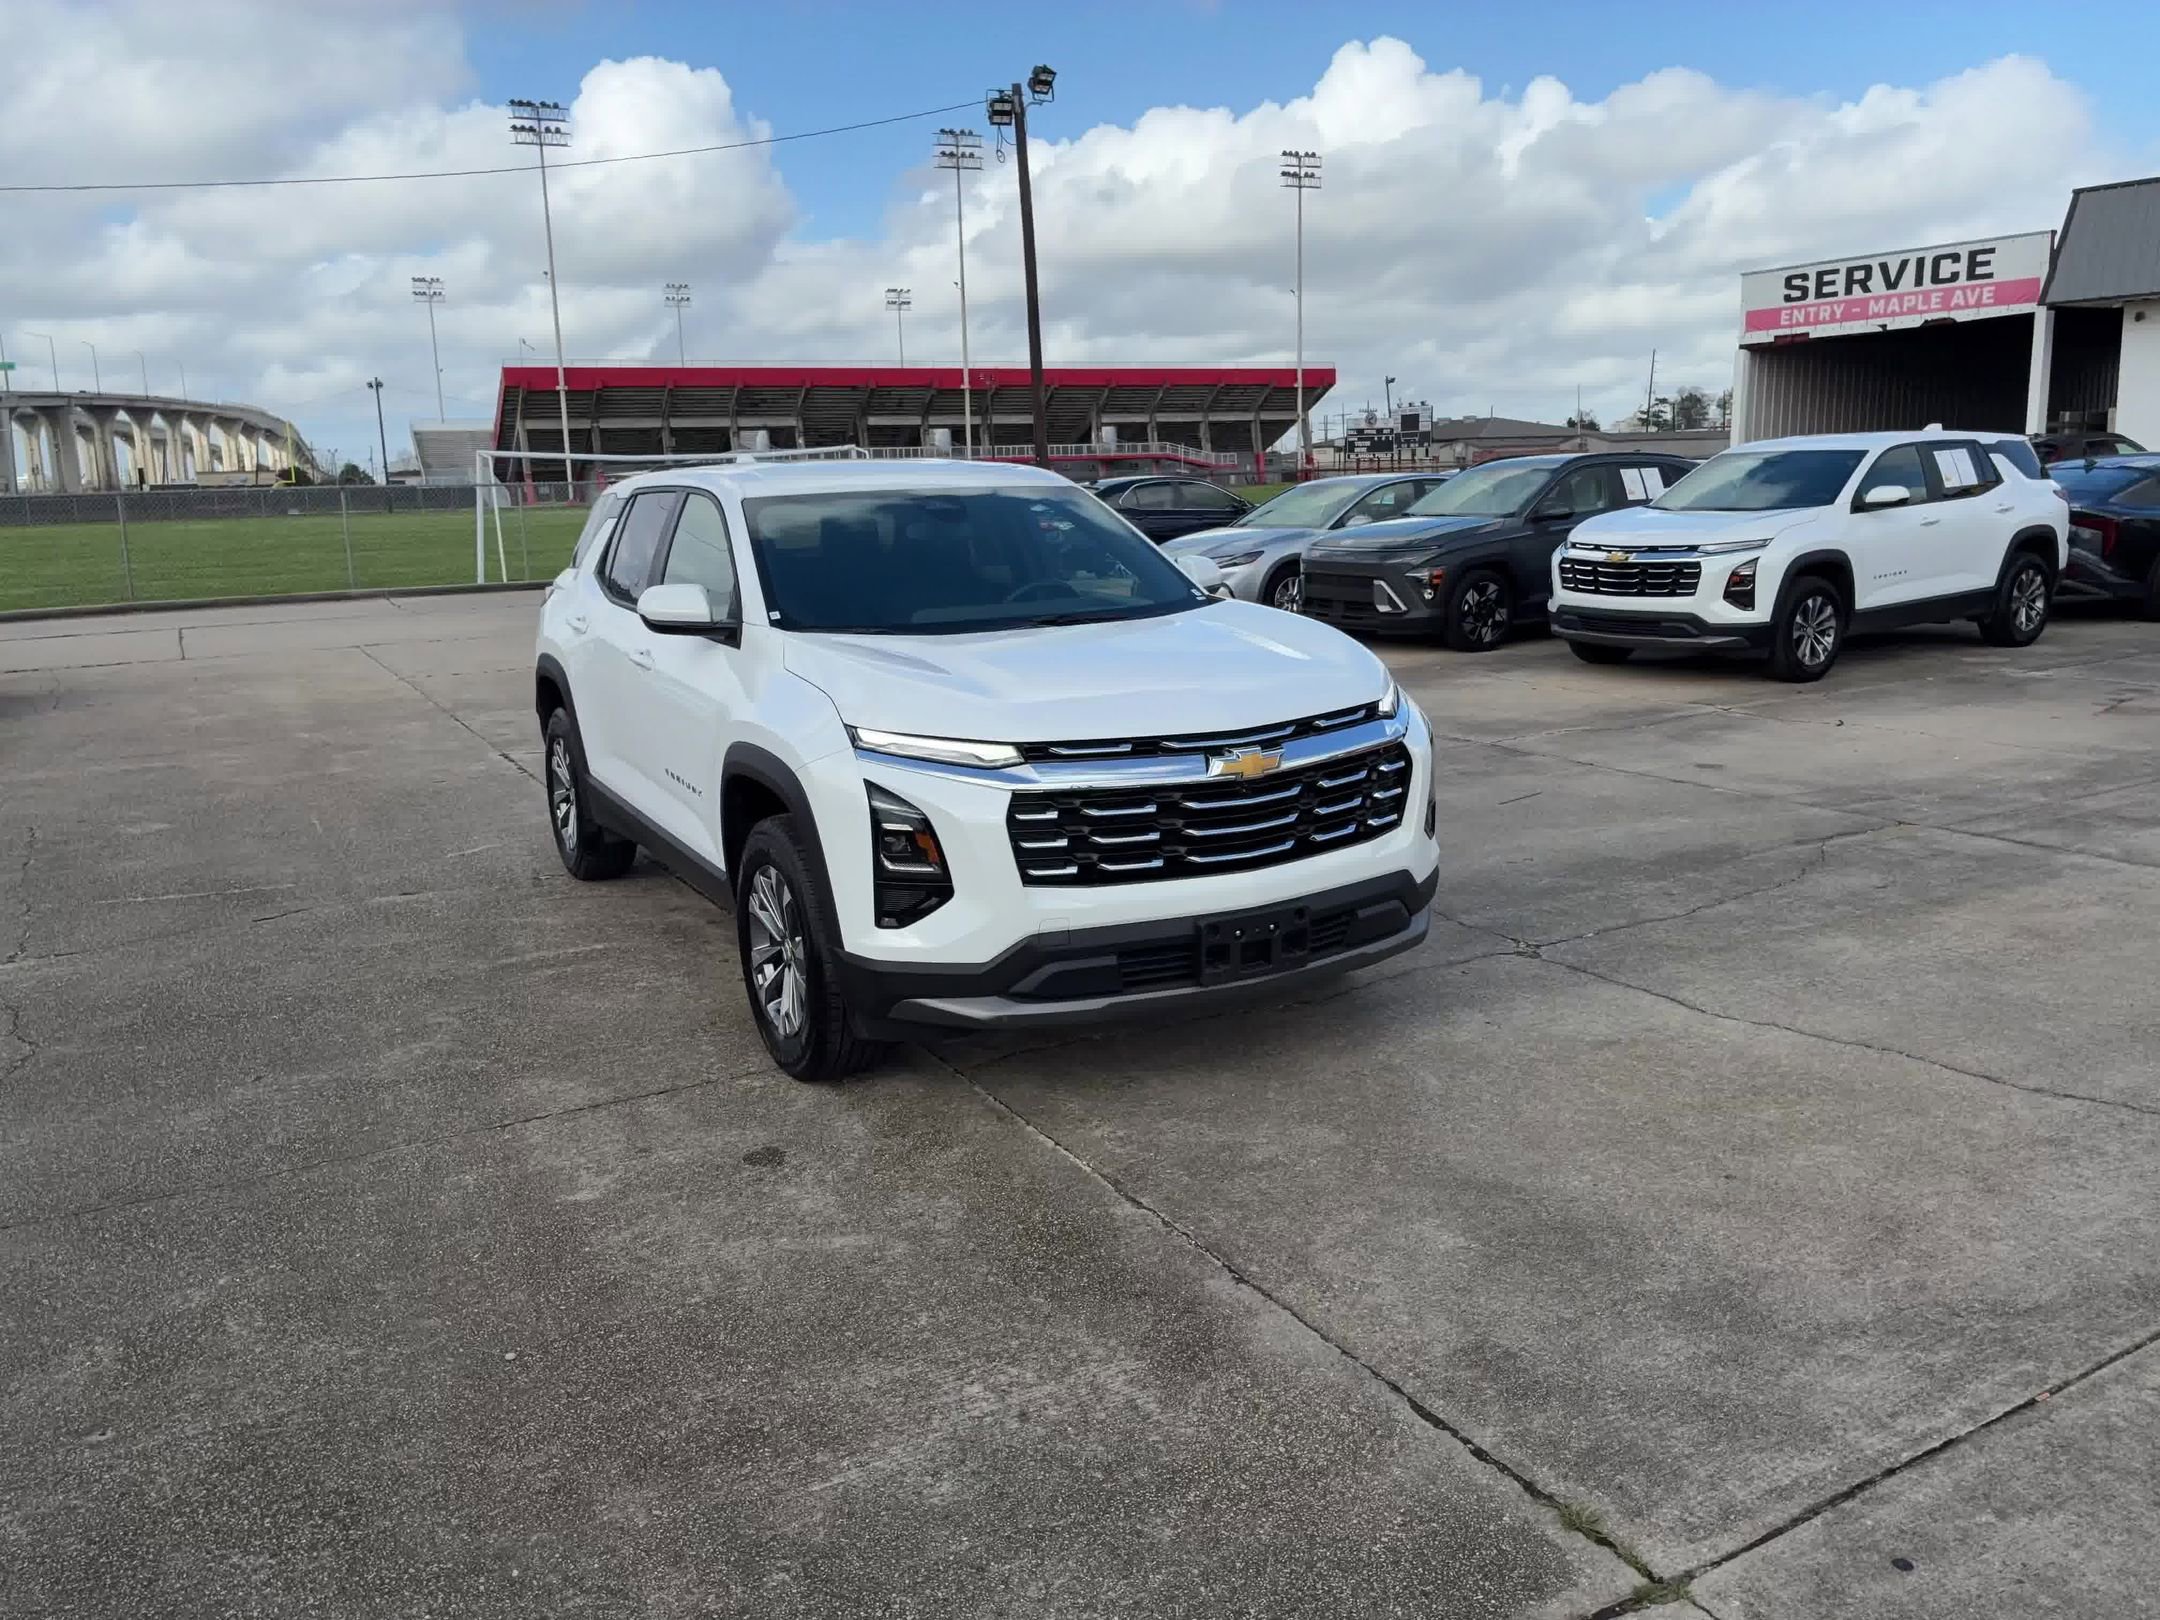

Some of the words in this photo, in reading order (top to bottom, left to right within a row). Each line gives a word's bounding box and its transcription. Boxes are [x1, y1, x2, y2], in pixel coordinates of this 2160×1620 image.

[1783, 247, 1996, 303] SERVICE
[1780, 305, 1845, 326] ENTRY
[1868, 291, 1943, 315] MAPLE
[1950, 286, 1995, 306] AVE
